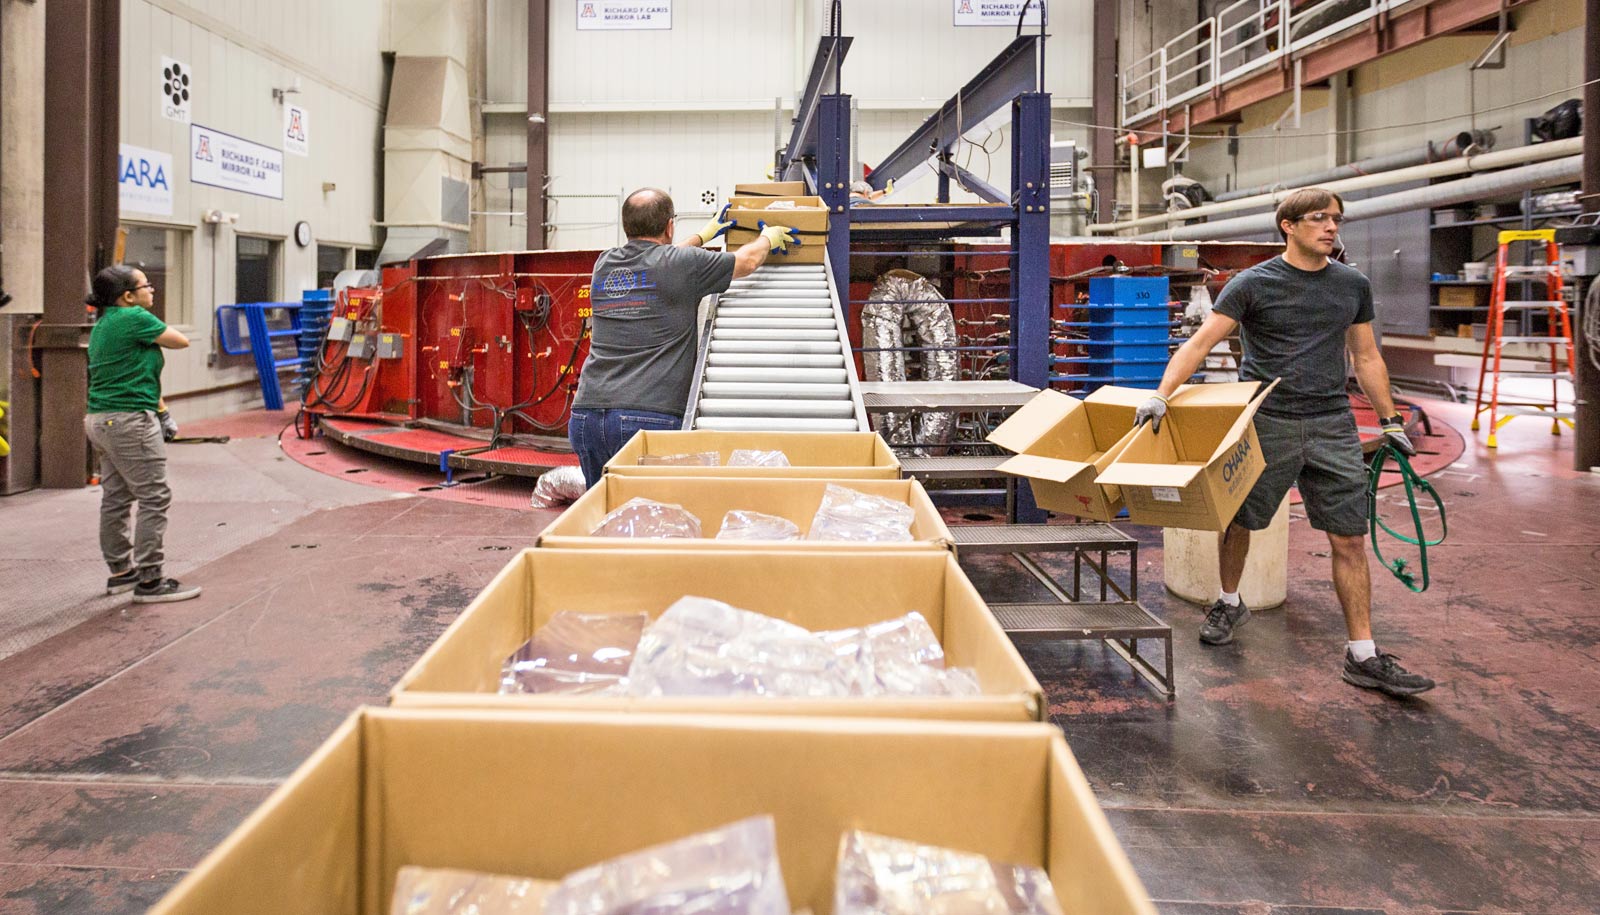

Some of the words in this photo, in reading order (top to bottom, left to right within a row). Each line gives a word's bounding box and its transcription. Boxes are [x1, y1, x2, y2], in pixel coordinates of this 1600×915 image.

[167, 106, 186, 119] GMT
[221, 148, 254, 166] RICHARD
[262, 160, 281, 173] CARIS
[221, 161, 251, 176] MIRROR
[253, 169, 266, 180] LAB
[1136, 291, 1150, 300] 330
[1223, 439, 1251, 482] OHARA
